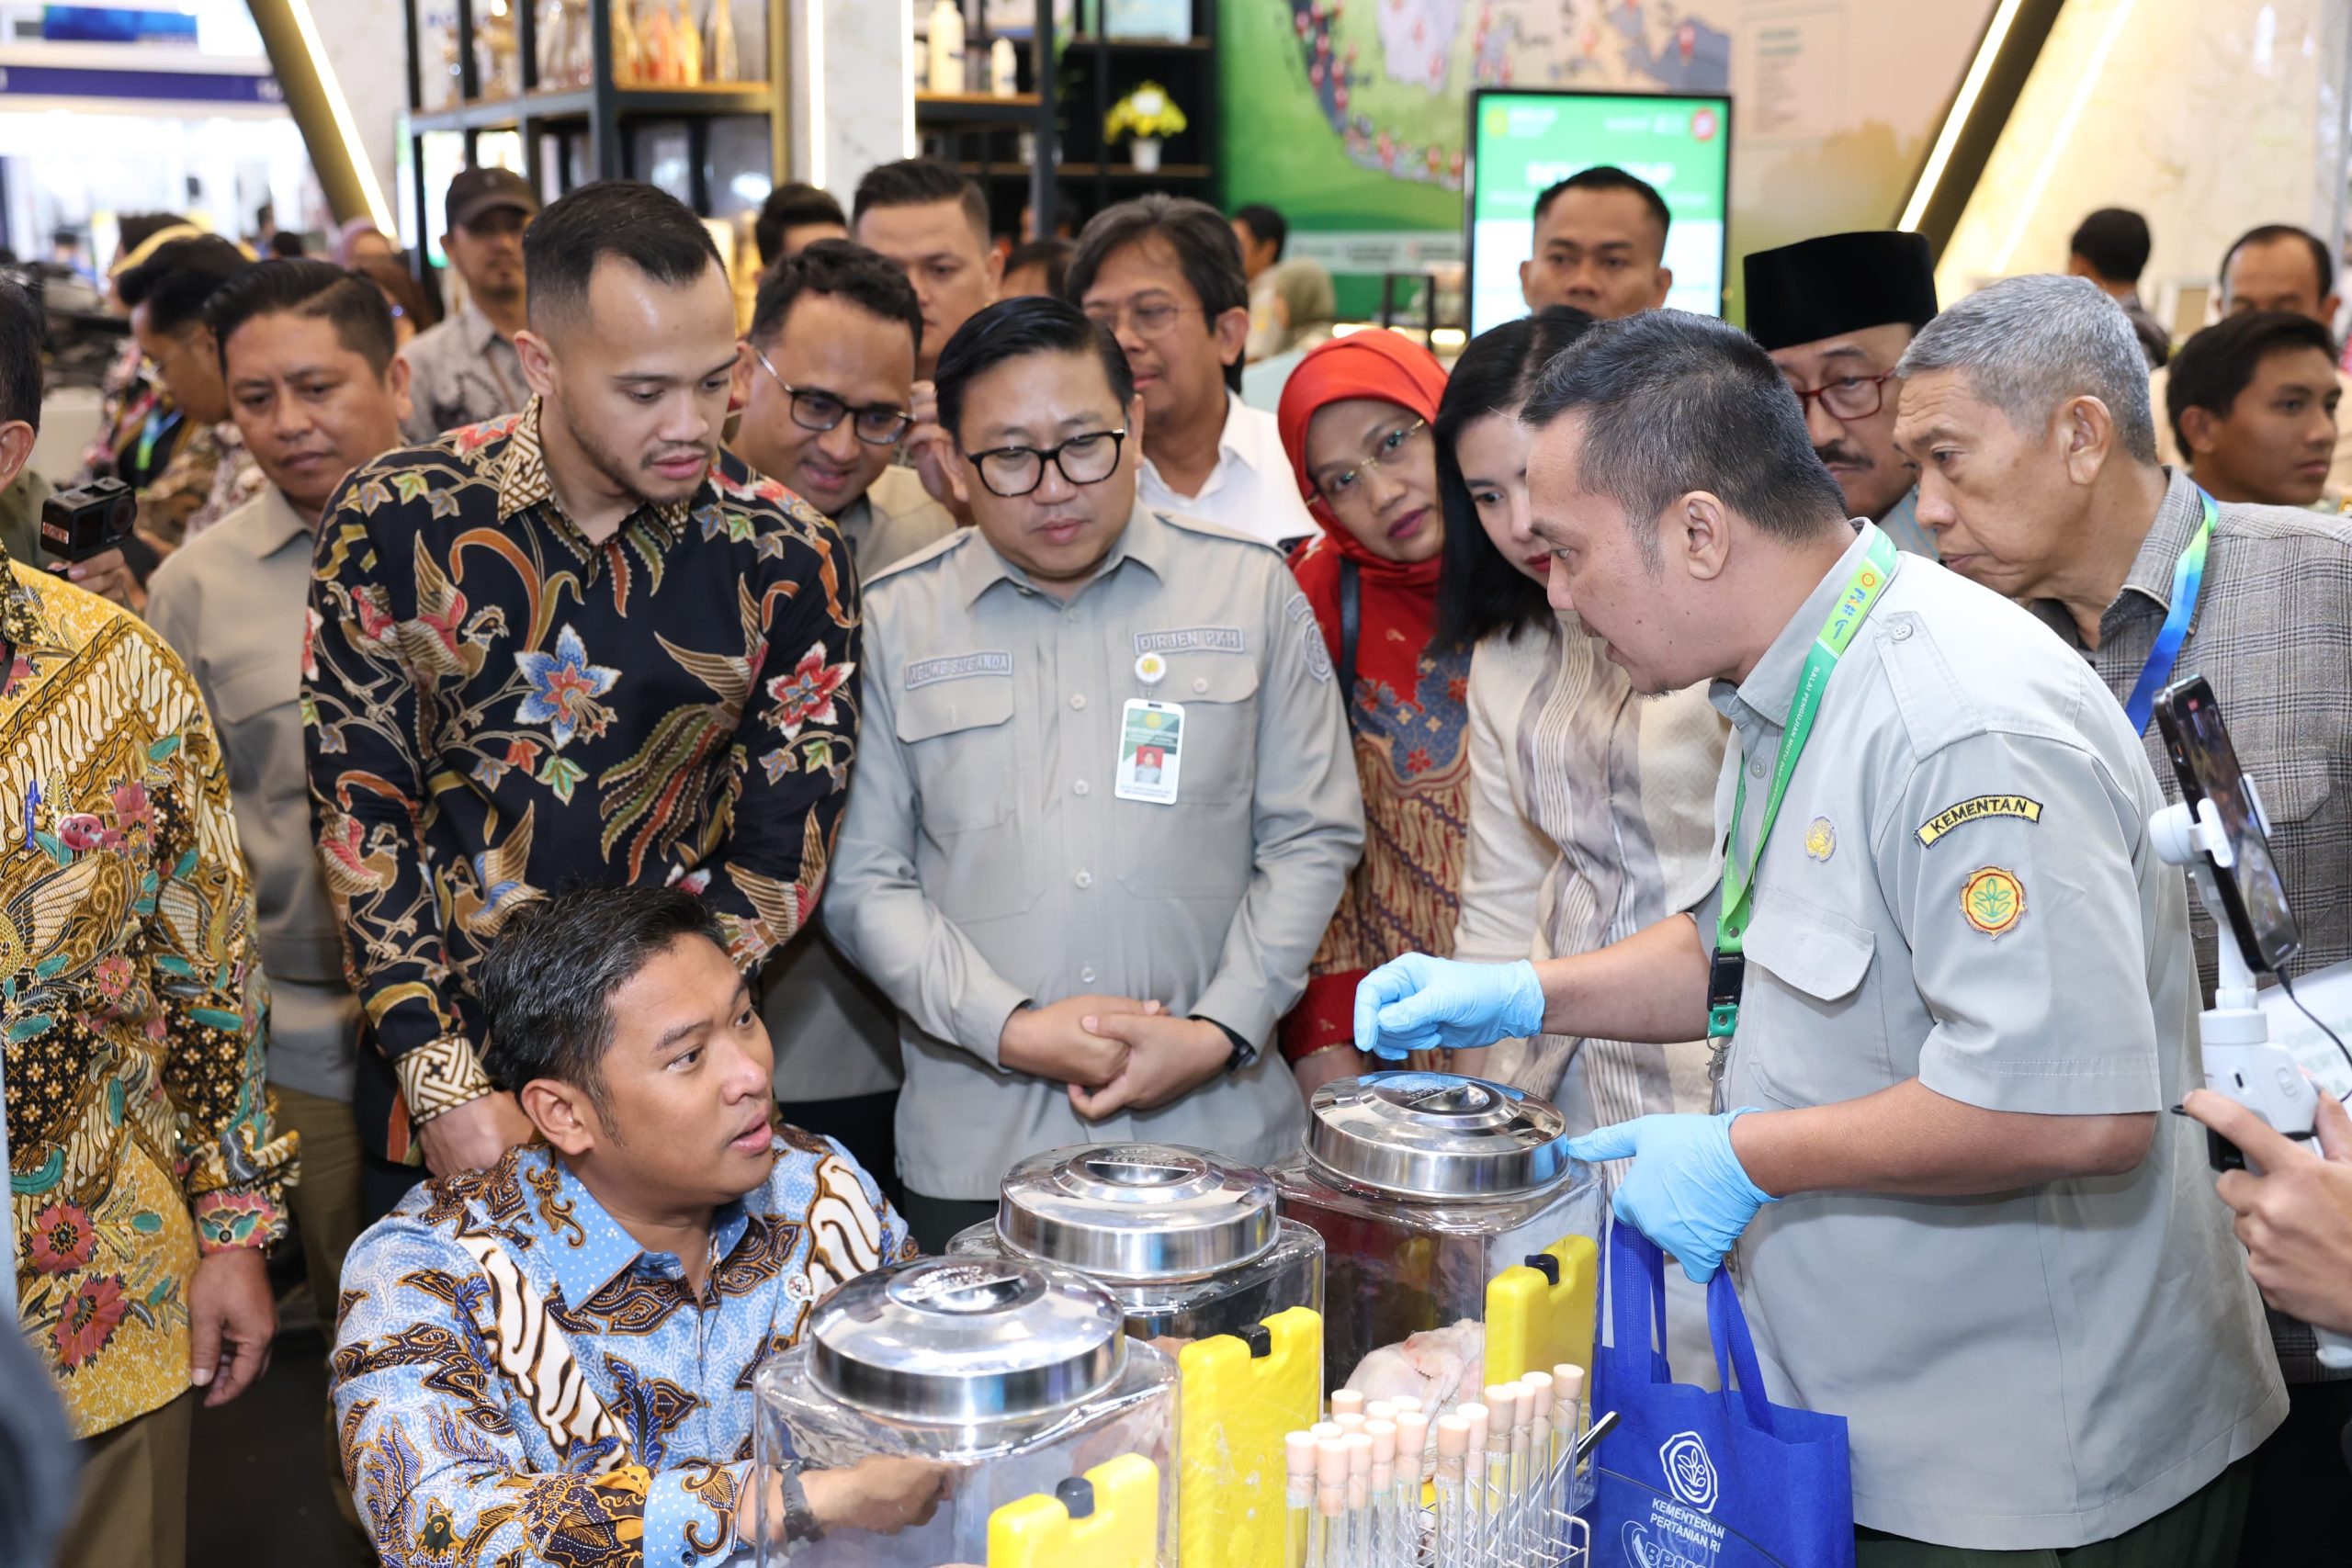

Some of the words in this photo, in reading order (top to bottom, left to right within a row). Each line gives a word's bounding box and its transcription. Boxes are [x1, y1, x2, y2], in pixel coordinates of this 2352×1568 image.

[1139, 630, 1197, 649] DIRJEN
[1204, 629, 1238, 648] PKH
[1805, 665, 1820, 691] BALAI
[1791, 692, 1809, 738] PENGUJIAN
[1783, 738, 1794, 761] MUTU
[1930, 799, 2028, 833] KEMENTAN
[1649, 1513, 1708, 1547] PERTANIAN
[1709, 1540, 1722, 1553] RI
[1651, 1497, 1725, 1540] KEMENTERIAN
